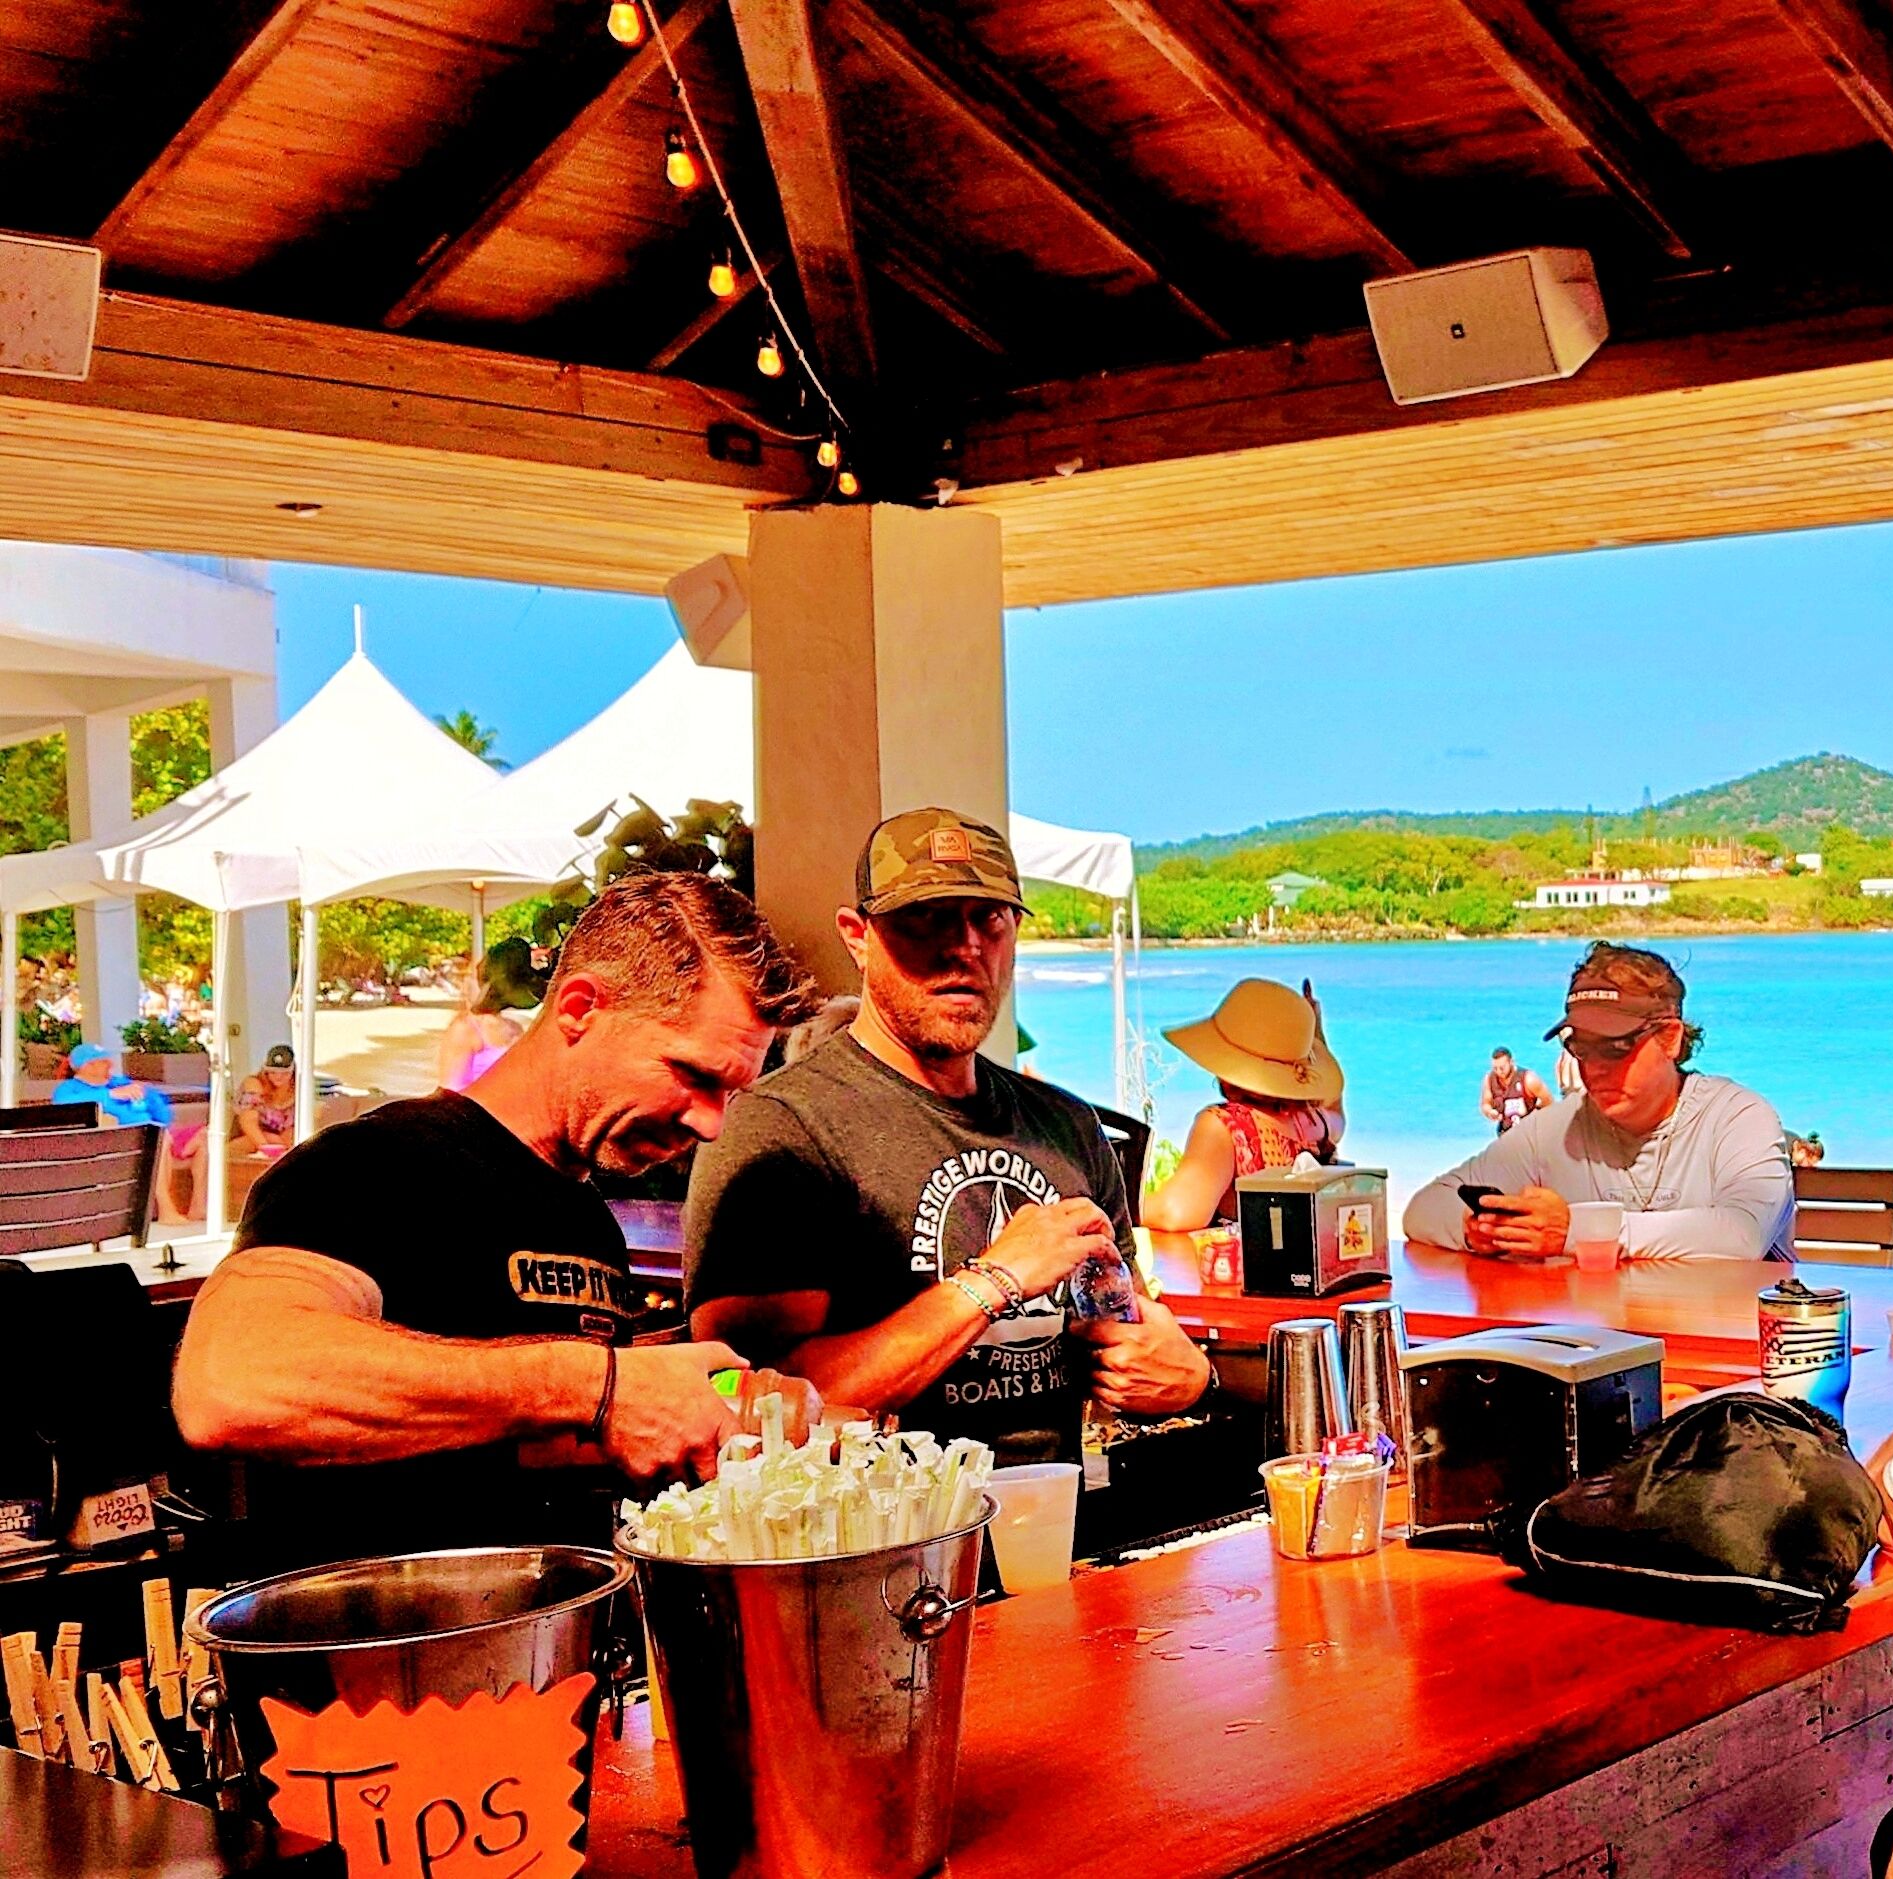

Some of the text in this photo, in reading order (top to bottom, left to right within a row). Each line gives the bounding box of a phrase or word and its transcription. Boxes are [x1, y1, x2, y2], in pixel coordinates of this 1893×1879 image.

[960, 1149, 1061, 1207] WORLDW
[517, 1258, 587, 1297] KEEP
[1765, 1348, 1845, 1366] ETERAN
[945, 1374, 1024, 1405] BOATS
[1030, 1372, 1043, 1394] &
[97, 1493, 139, 1513] LIGHT
